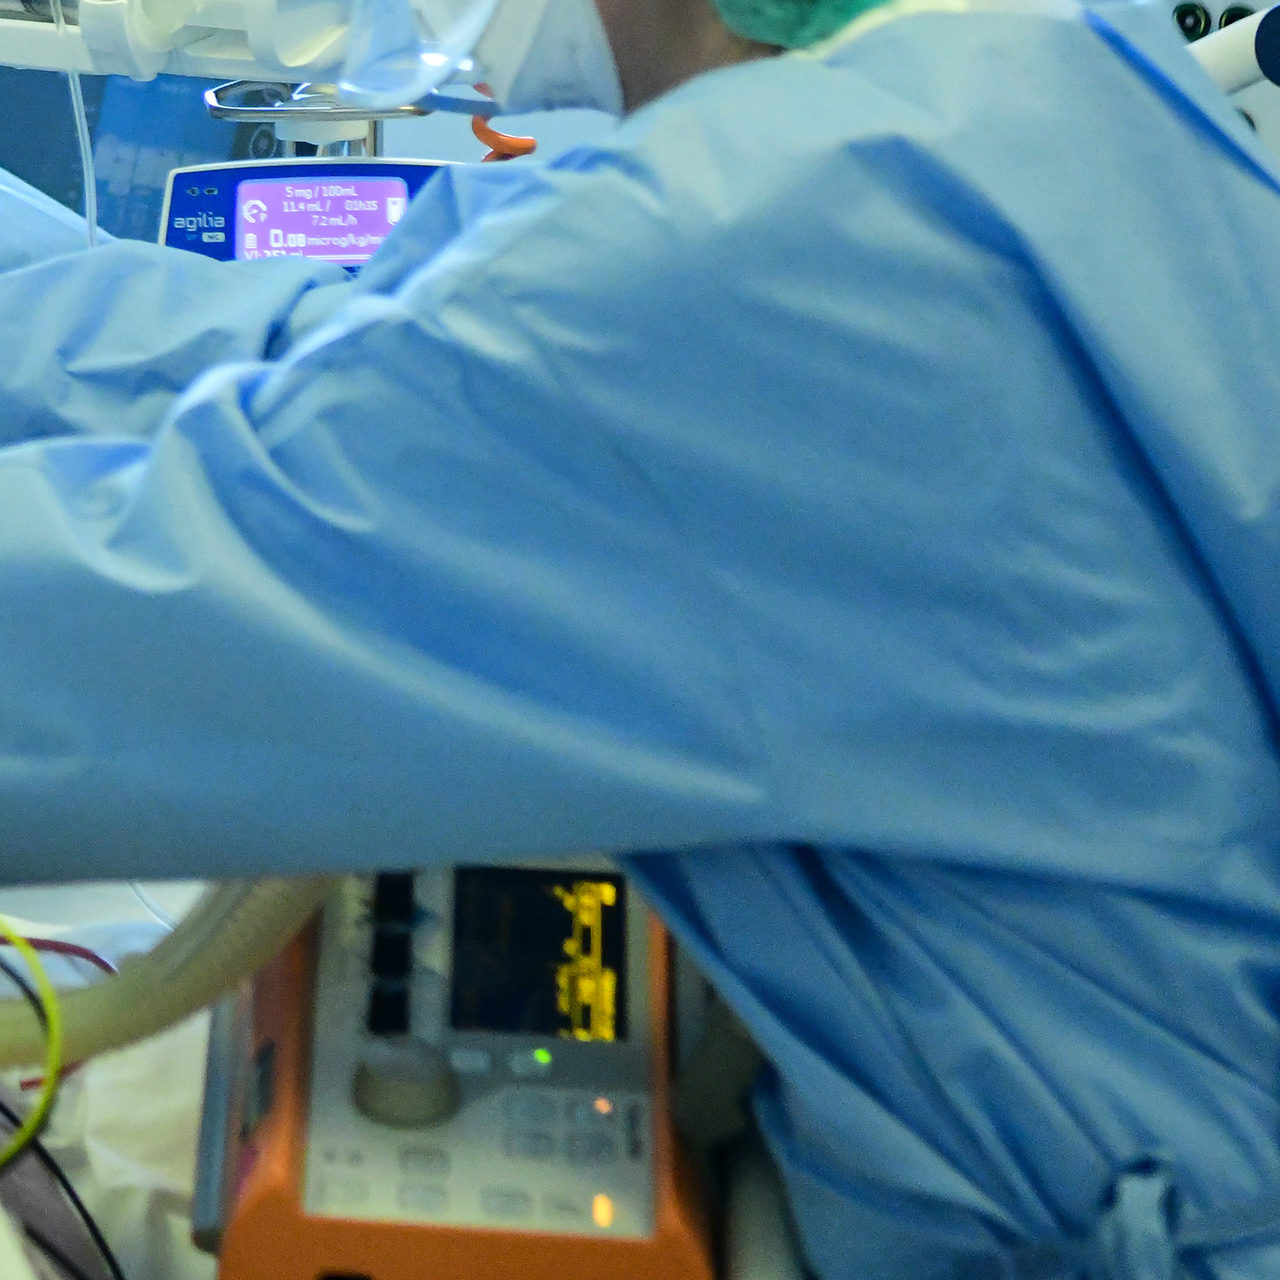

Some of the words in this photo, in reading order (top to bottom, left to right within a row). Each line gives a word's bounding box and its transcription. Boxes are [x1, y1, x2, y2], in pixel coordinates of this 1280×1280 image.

[286, 186, 293, 198] 5
[295, 188, 313, 199] mg
[174, 211, 225, 231] agilia
